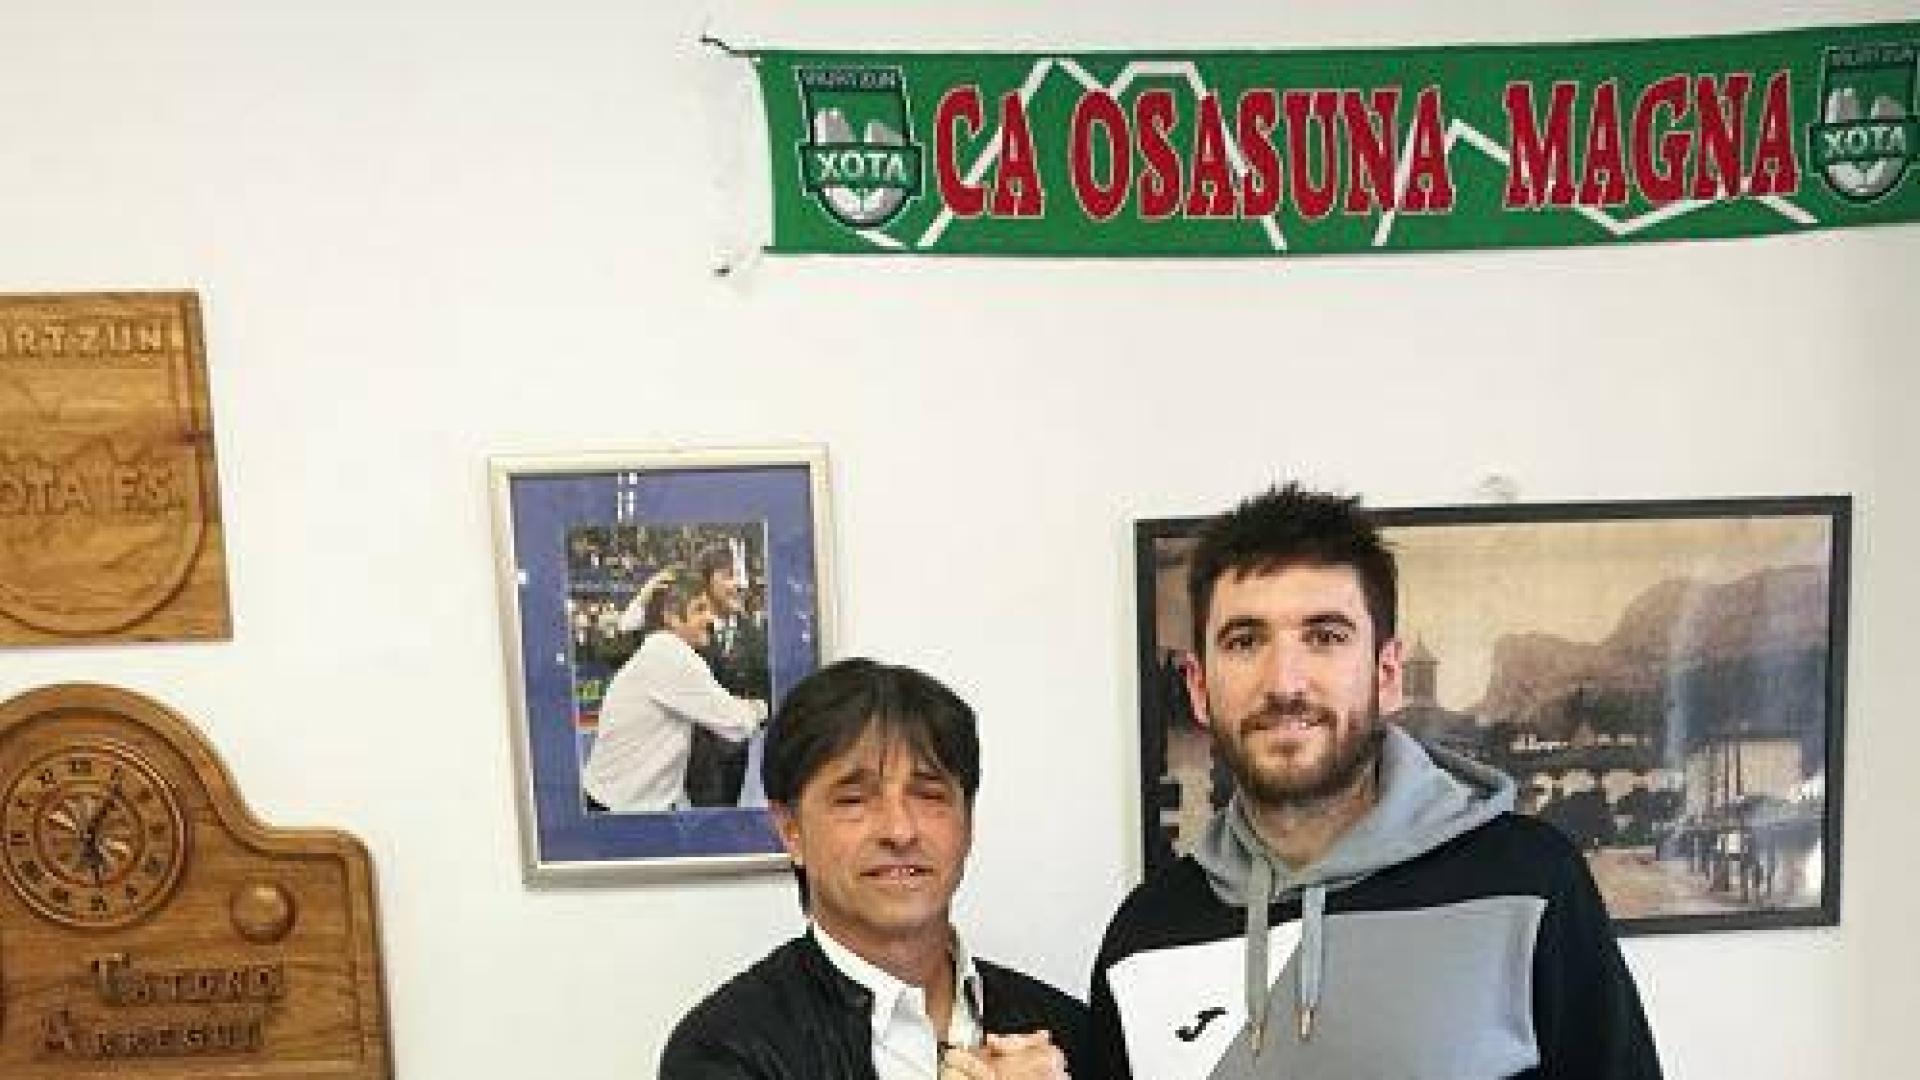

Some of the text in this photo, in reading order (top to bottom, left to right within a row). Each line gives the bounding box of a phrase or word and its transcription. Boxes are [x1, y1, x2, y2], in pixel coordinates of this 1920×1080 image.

[933, 68, 1799, 220] CA OSASUNA MAGNA
[1822, 124, 1907, 157] XOTA
[815, 150, 908, 182] XOTA
